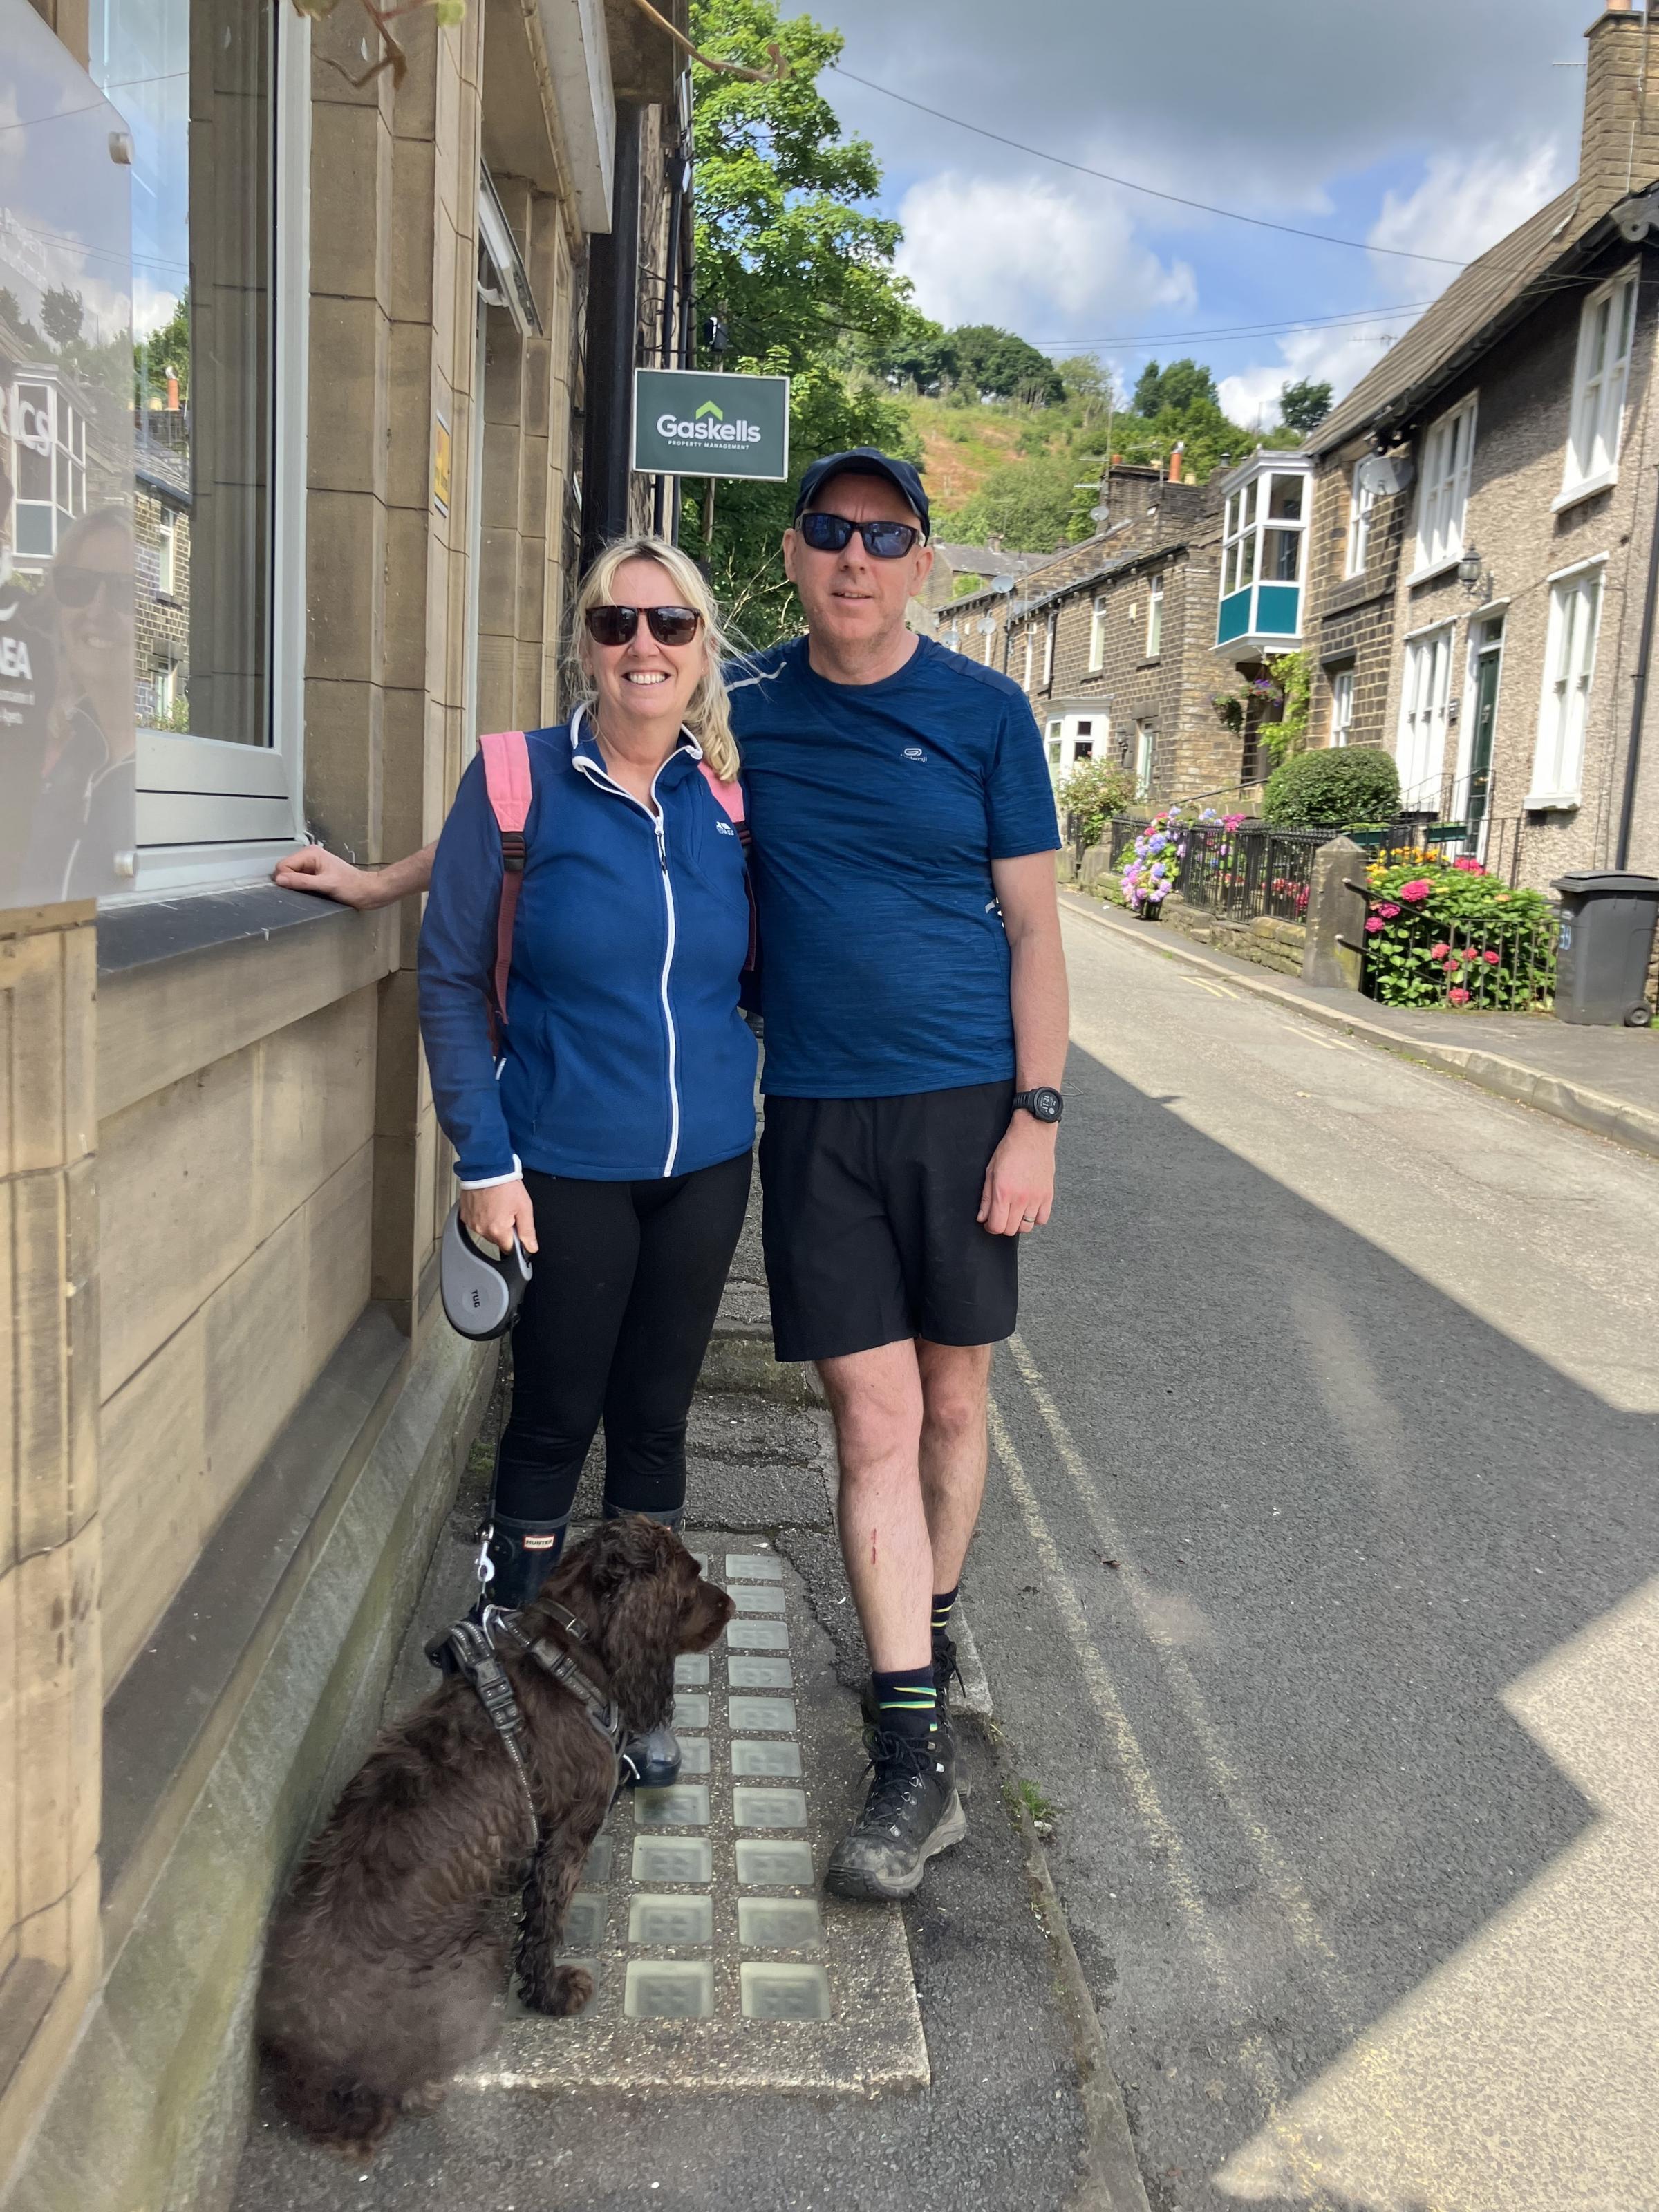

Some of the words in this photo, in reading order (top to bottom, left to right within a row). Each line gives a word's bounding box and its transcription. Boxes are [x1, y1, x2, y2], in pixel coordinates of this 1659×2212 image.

[657, 414, 761, 443] Gaskells
[0, 636, 33, 680] EA
[471, 1288, 481, 1308] TUG
